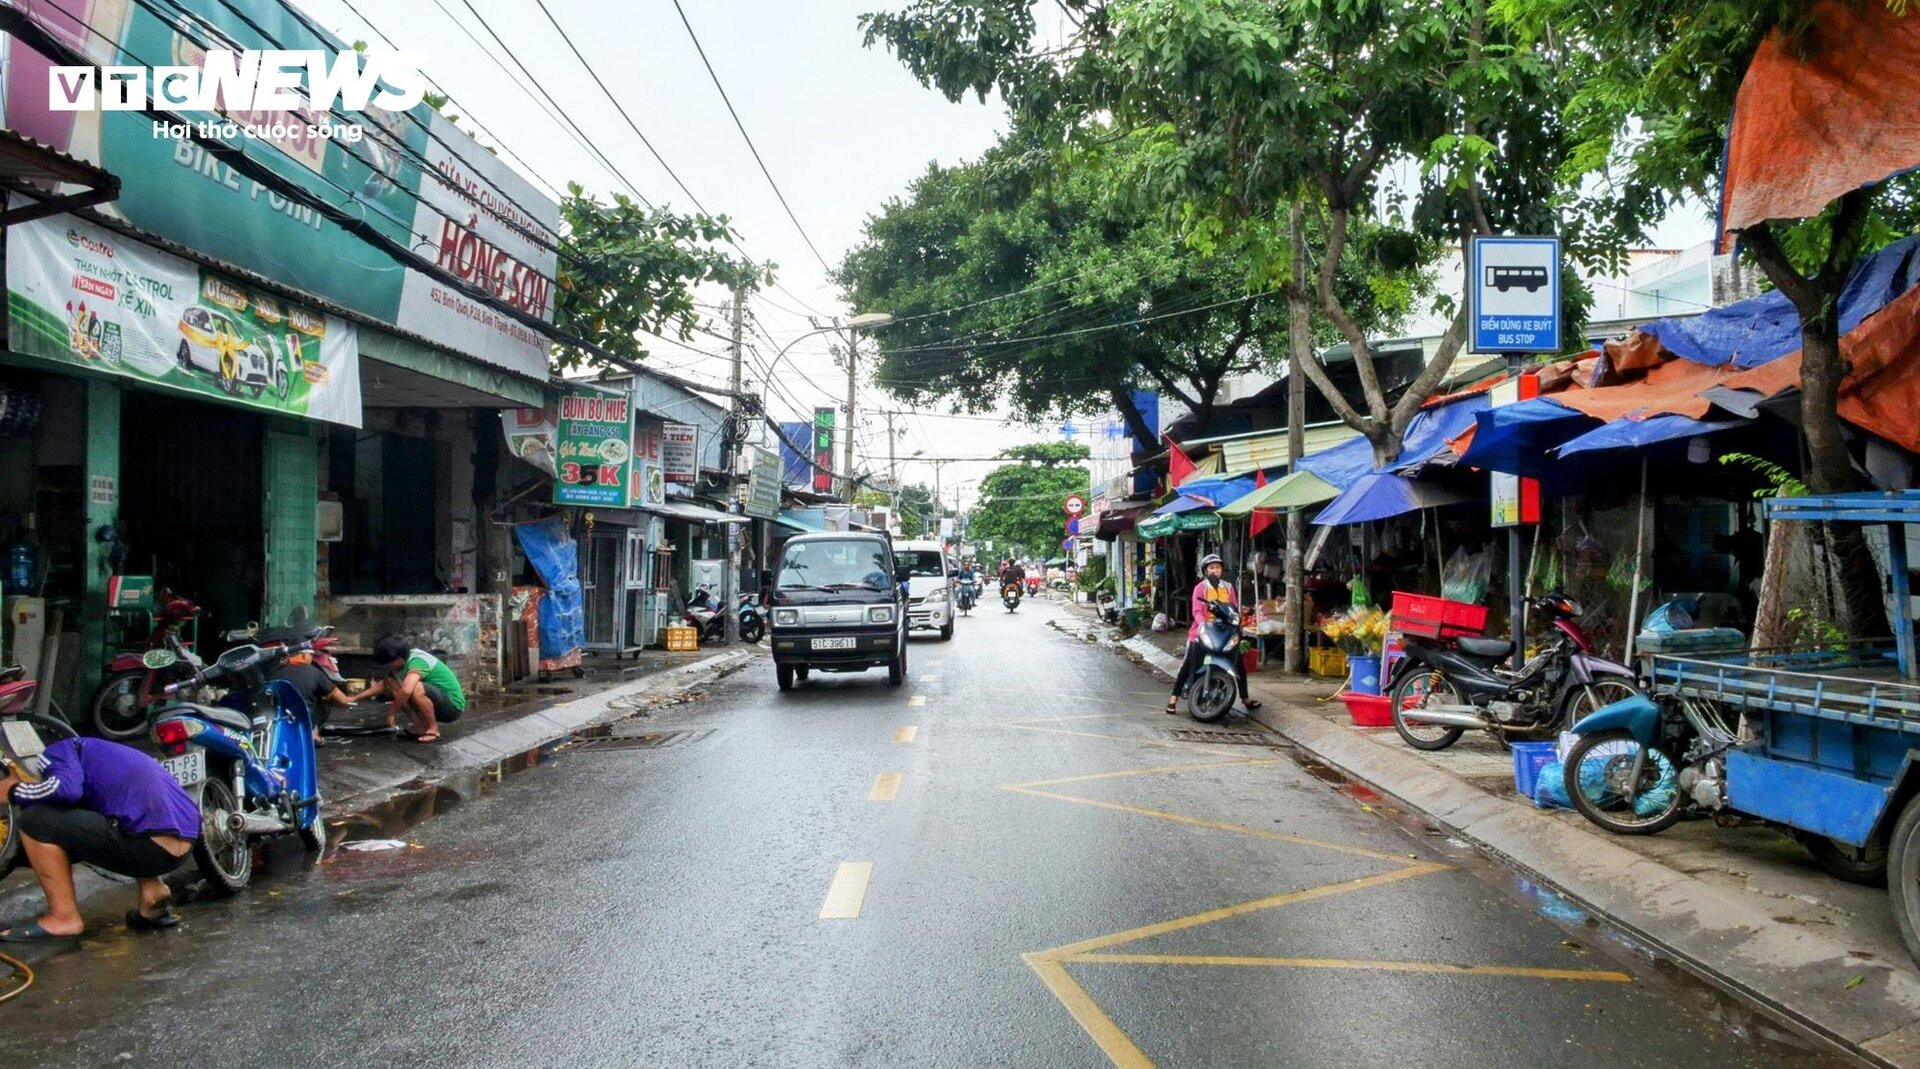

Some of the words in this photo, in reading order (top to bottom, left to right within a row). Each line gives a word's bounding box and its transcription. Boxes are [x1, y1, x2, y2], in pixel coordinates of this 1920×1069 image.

[80, 236, 116, 258] Castro
[438, 213, 508, 297] HỒNG
[74, 258, 99, 274] THAY
[1481, 316, 1499, 330] ĐIỂM
[1500, 318, 1520, 330] DỪNG
[1522, 321, 1533, 330] XE
[1533, 318, 1552, 330] BUÝT
[1498, 334, 1514, 344] BUS
[1515, 334, 1536, 344] STOP
[562, 393, 586, 420] BÚN
[587, 393, 604, 421] BÒ
[604, 394, 630, 423] HUẾ
